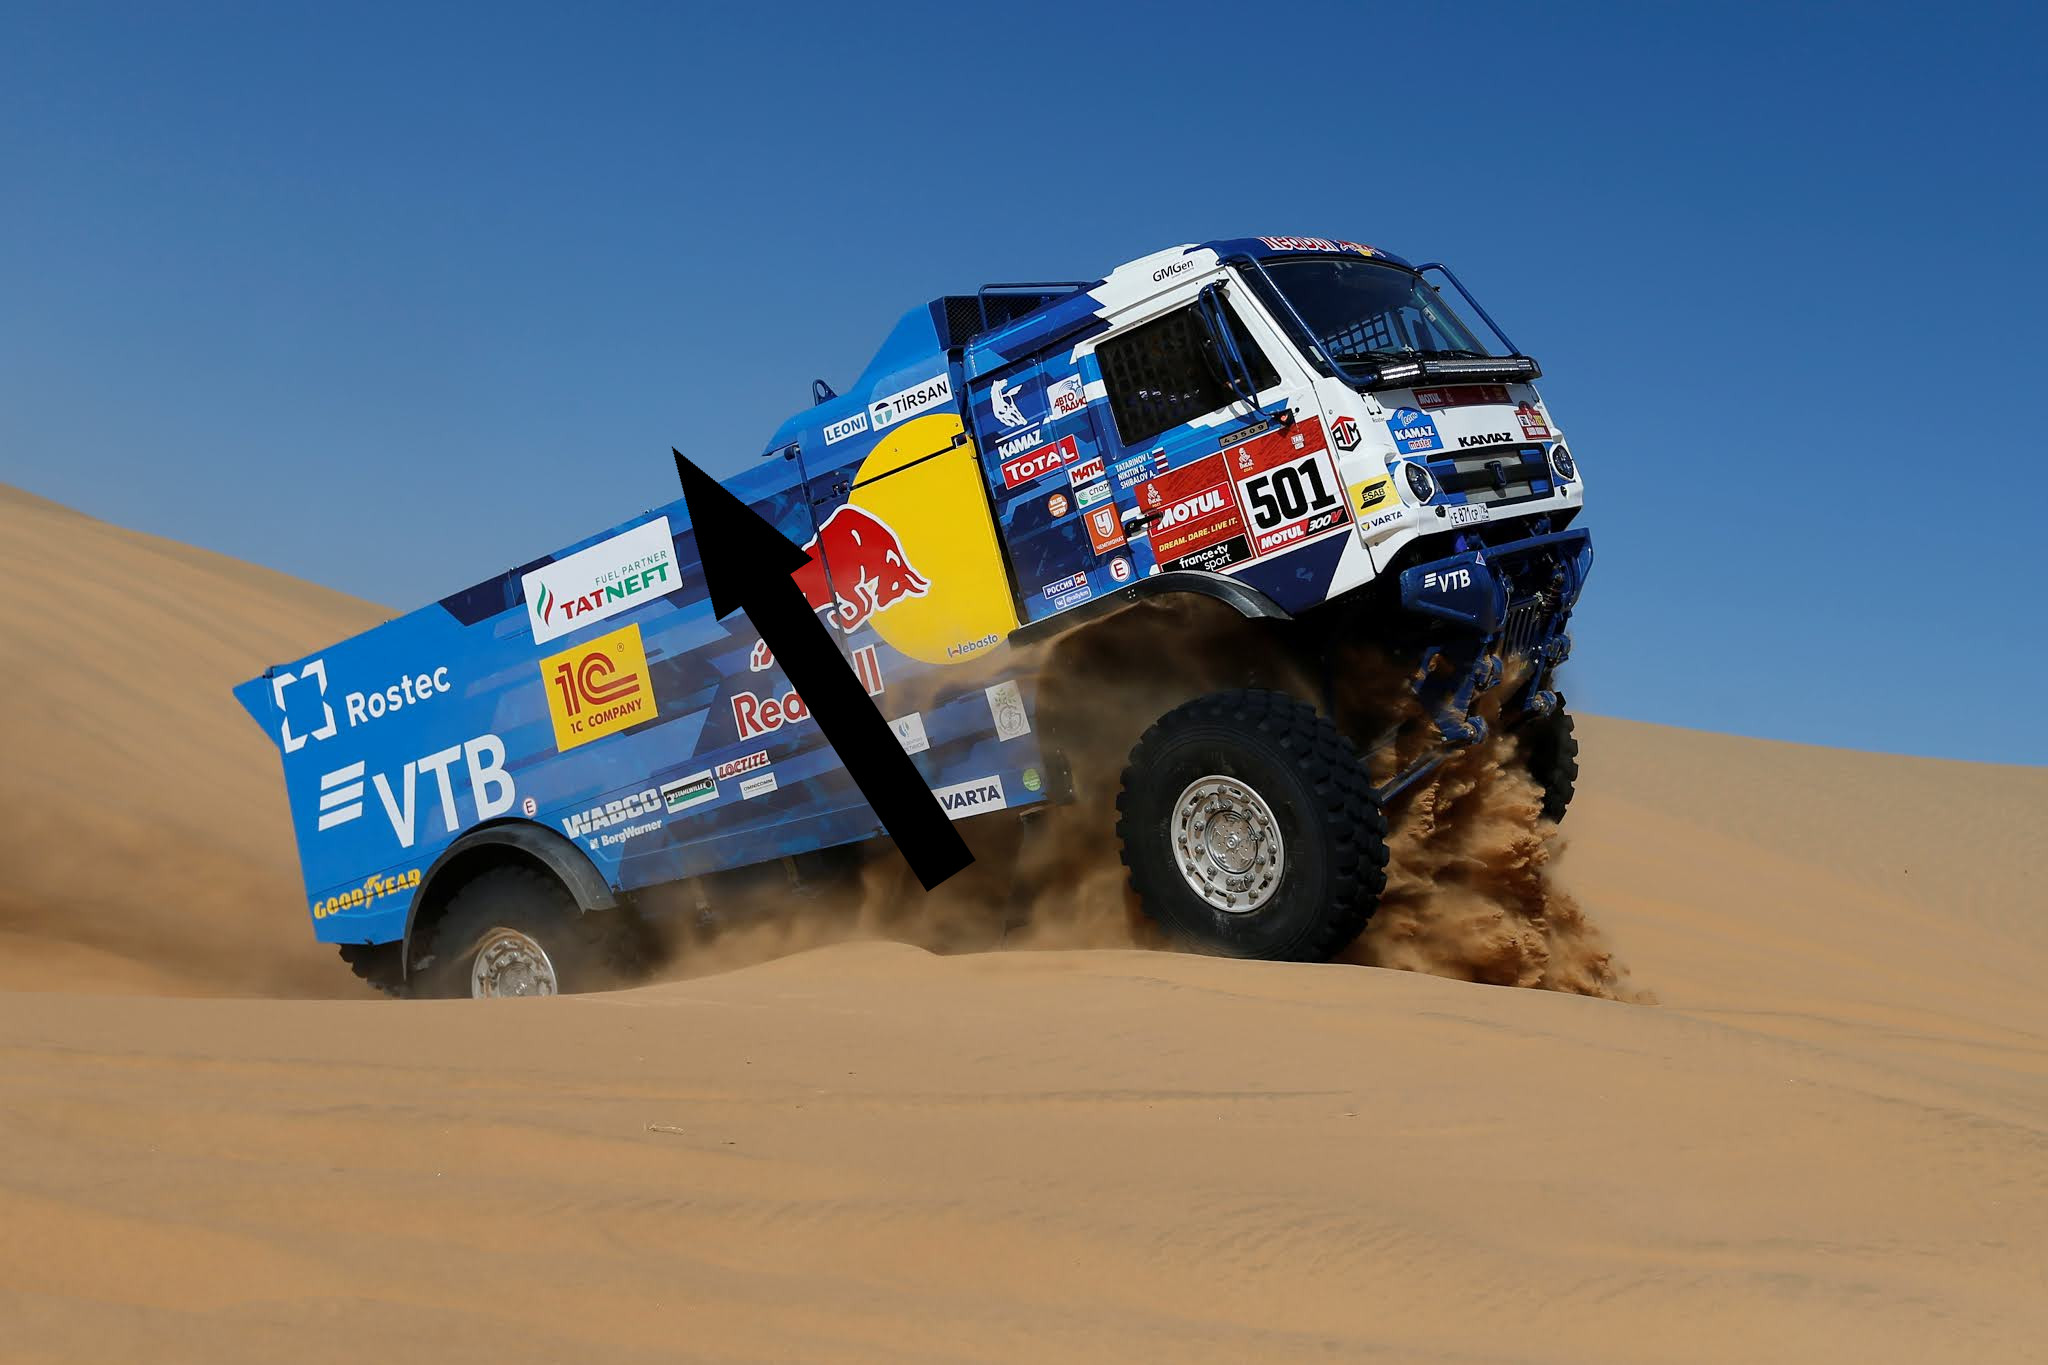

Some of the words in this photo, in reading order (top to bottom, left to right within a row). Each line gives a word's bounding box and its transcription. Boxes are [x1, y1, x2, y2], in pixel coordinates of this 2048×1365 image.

[1153, 260, 1194, 282] GMGen
[1054, 392, 1075, 409] АВТО
[1418, 393, 1442, 404] MOTUL
[826, 416, 866, 441] LEONI
[1394, 425, 1435, 441] KAMAZ
[1458, 432, 1513, 448] KAMAZ
[998, 429, 1044, 460] KAMAZ
[1408, 439, 1432, 449] master
[1005, 446, 1075, 481] TOTAL
[1115, 456, 1147, 472] TATARINOV
[1117, 468, 1138, 481] NIKITIN
[1120, 472, 1150, 489] SHIBALOV
[1246, 458, 1337, 530] 501
[1361, 487, 1386, 502] ESAB
[1157, 490, 1225, 531] MOTUL
[1370, 511, 1403, 528] VARTA
[1158, 536, 1188, 553] DREAM.
[1187, 527, 1211, 542] DARE.
[1211, 520, 1228, 533] LIVE
[1228, 517, 1238, 526] IT.
[1261, 526, 1305, 550] MOTUL
[1308, 509, 1343, 533] 300V
[595, 570, 618, 587] FUEL
[621, 550, 668, 576] PARTNER
[1204, 554, 1233, 572] sport
[560, 561, 670, 621] TATNEFT
[1046, 578, 1075, 596] РОССИЯ
[1075, 575, 1086, 586] 24
[1438, 568, 1471, 593] VTB
[345, 664, 452, 728] Rostec
[571, 720, 584, 735] 1C
[588, 697, 643, 728] COMPANY
[731, 690, 809, 741] Red
[718, 752, 768, 779] LOCTITE
[372, 733, 517, 849] VTB
[940, 784, 1002, 811] VARTA
[561, 788, 662, 840] WABCO
[601, 818, 663, 848] BorgWarner
[314, 868, 421, 920] GOODYEAR
